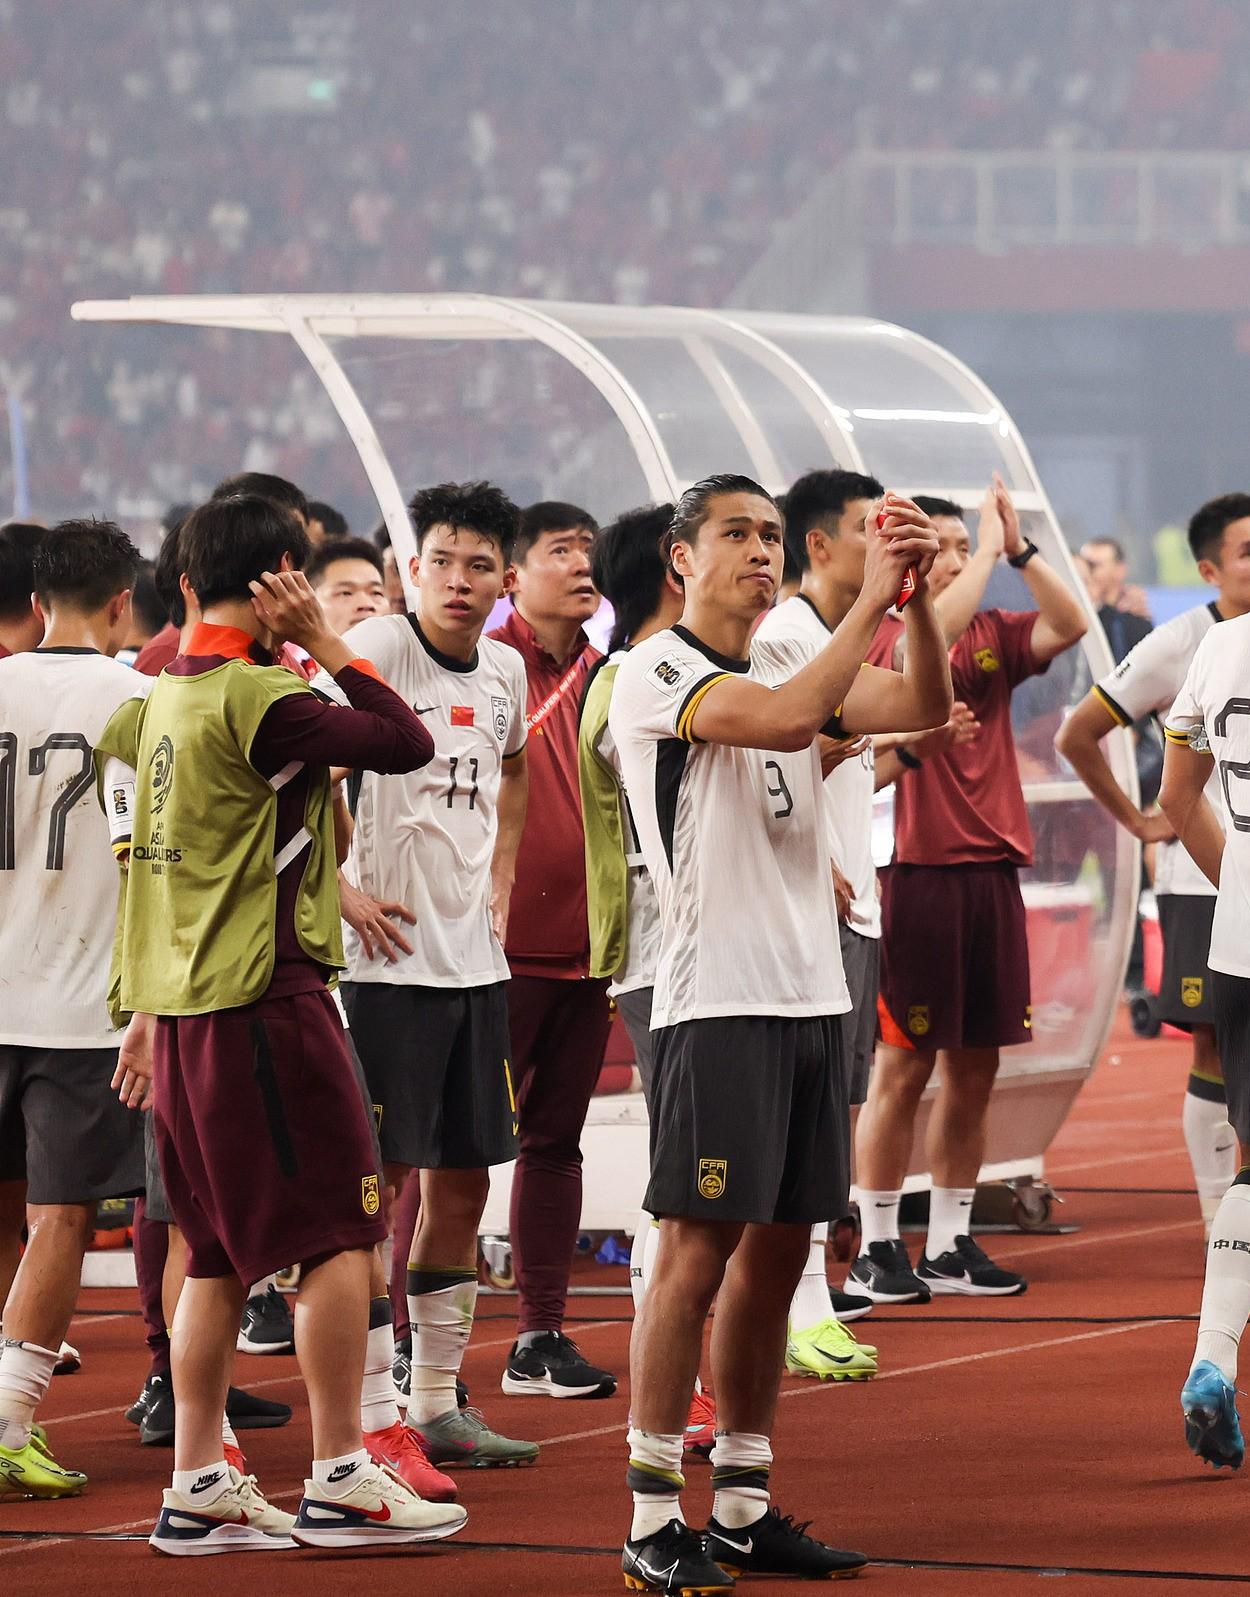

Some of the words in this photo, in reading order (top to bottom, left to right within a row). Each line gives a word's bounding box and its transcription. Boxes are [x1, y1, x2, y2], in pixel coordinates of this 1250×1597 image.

[0, 732, 96, 870] 17
[447, 757, 478, 810] 11
[765, 761, 793, 819] 9
[702, 1161, 724, 1170] CFA
